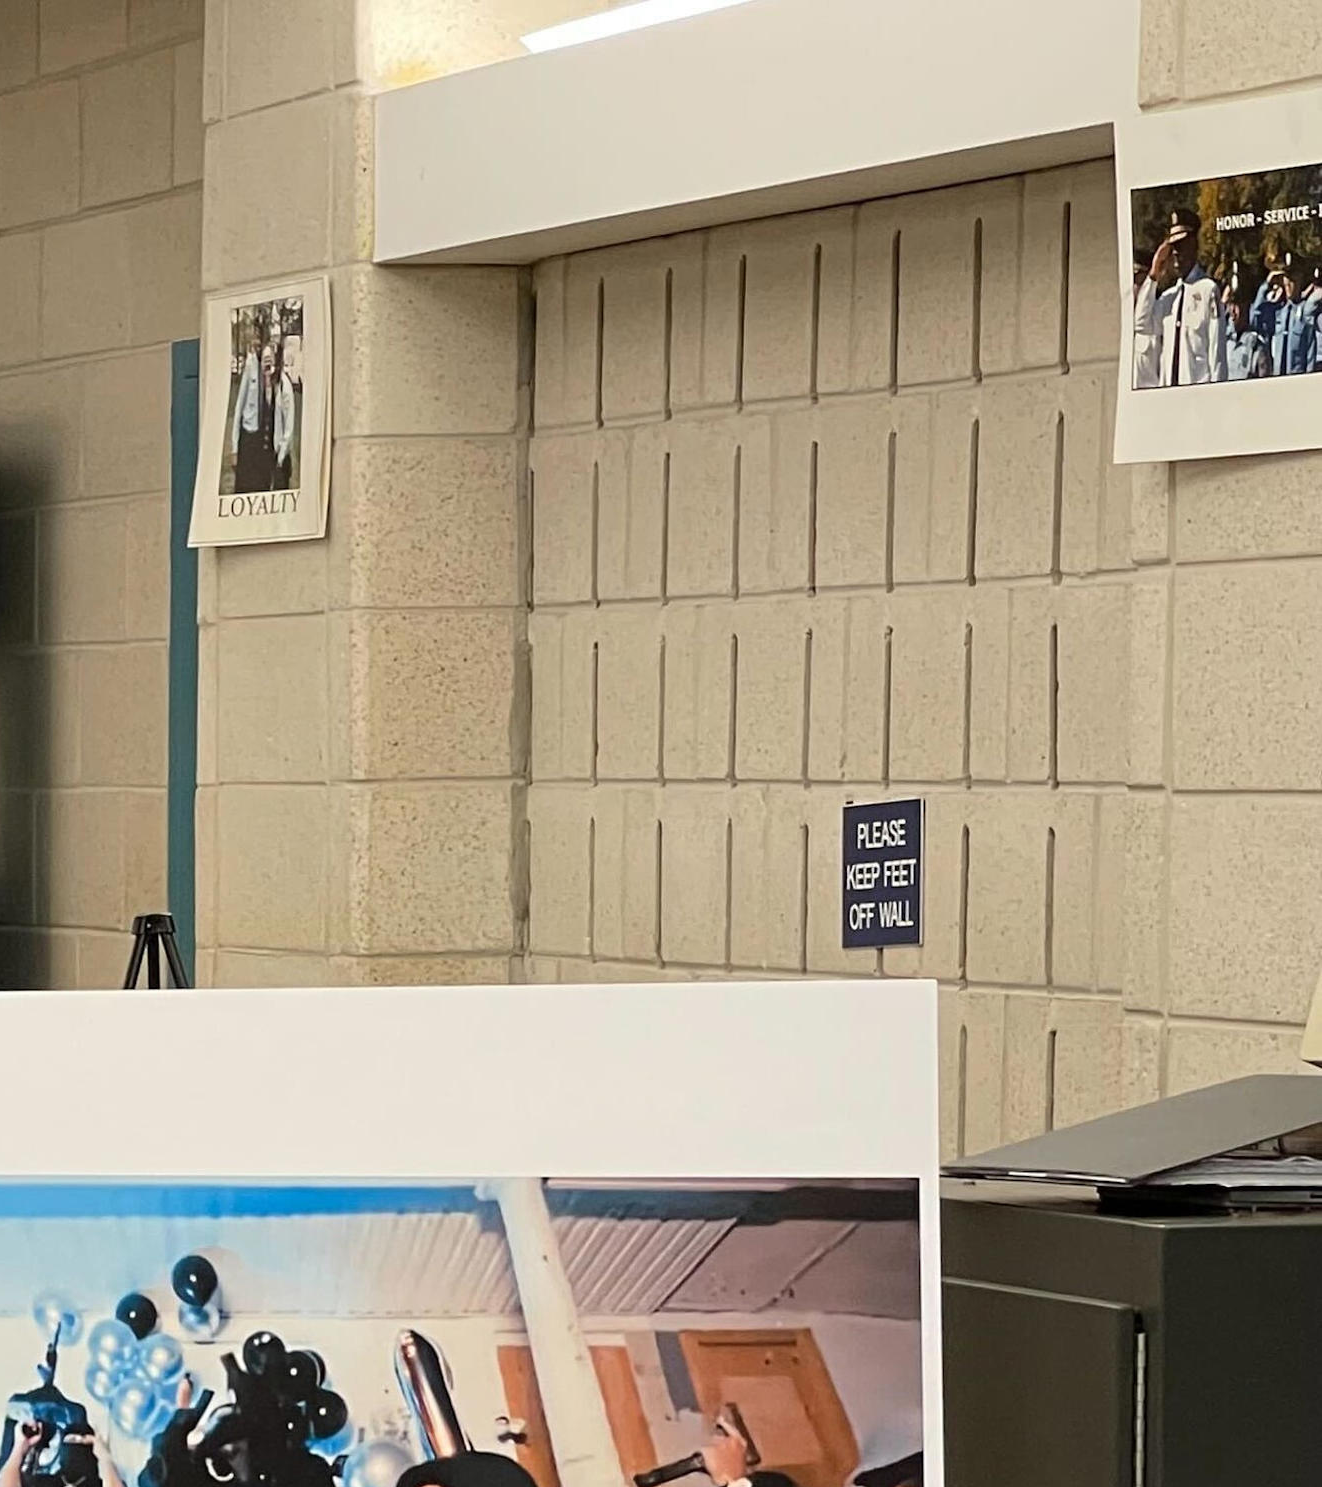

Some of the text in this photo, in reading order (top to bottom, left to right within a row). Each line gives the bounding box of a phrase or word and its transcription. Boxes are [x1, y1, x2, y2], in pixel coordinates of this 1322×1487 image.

[1216, 213, 1255, 231] HONOR
[1264, 205, 1310, 225] SERVICE
[218, 491, 301, 518] LOYALTY
[857, 819, 906, 849] PLEASE
[846, 858, 917, 890] KEEP FEET
[849, 900, 914, 930] OFF WALL
